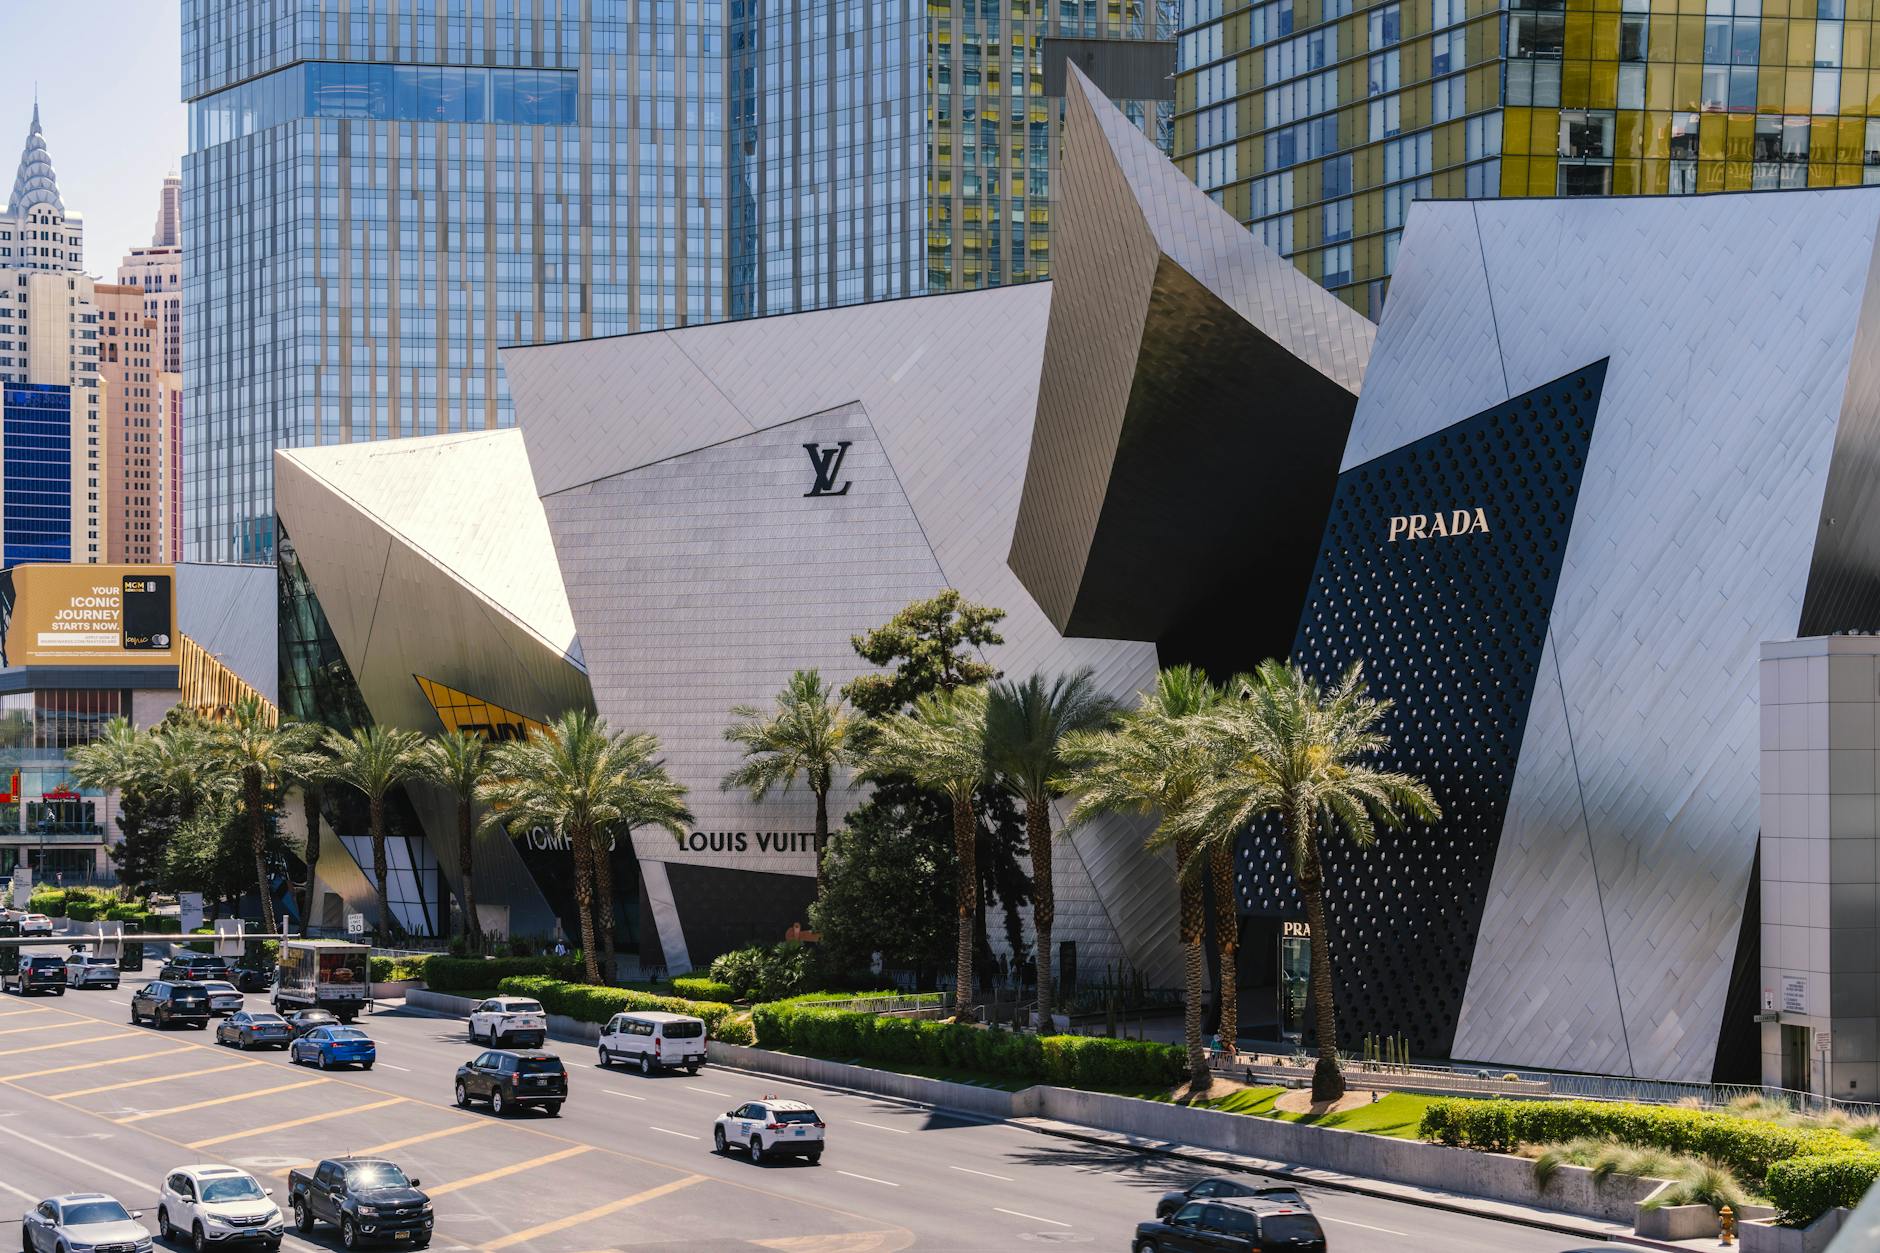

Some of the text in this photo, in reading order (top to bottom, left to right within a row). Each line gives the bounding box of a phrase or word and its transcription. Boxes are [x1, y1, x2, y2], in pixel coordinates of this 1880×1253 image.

[1387, 507, 1490, 542] PRADA
[91, 586, 120, 595] YOUR
[124, 581, 145, 589] MGM
[71, 597, 120, 608] ICONIC
[55, 609, 120, 620] JOURNEY
[51, 622, 120, 631] STARTS NOW.
[679, 832, 748, 852] LOUIS
[350, 924, 362, 932] 30
[1283, 921, 1311, 936] PRA
